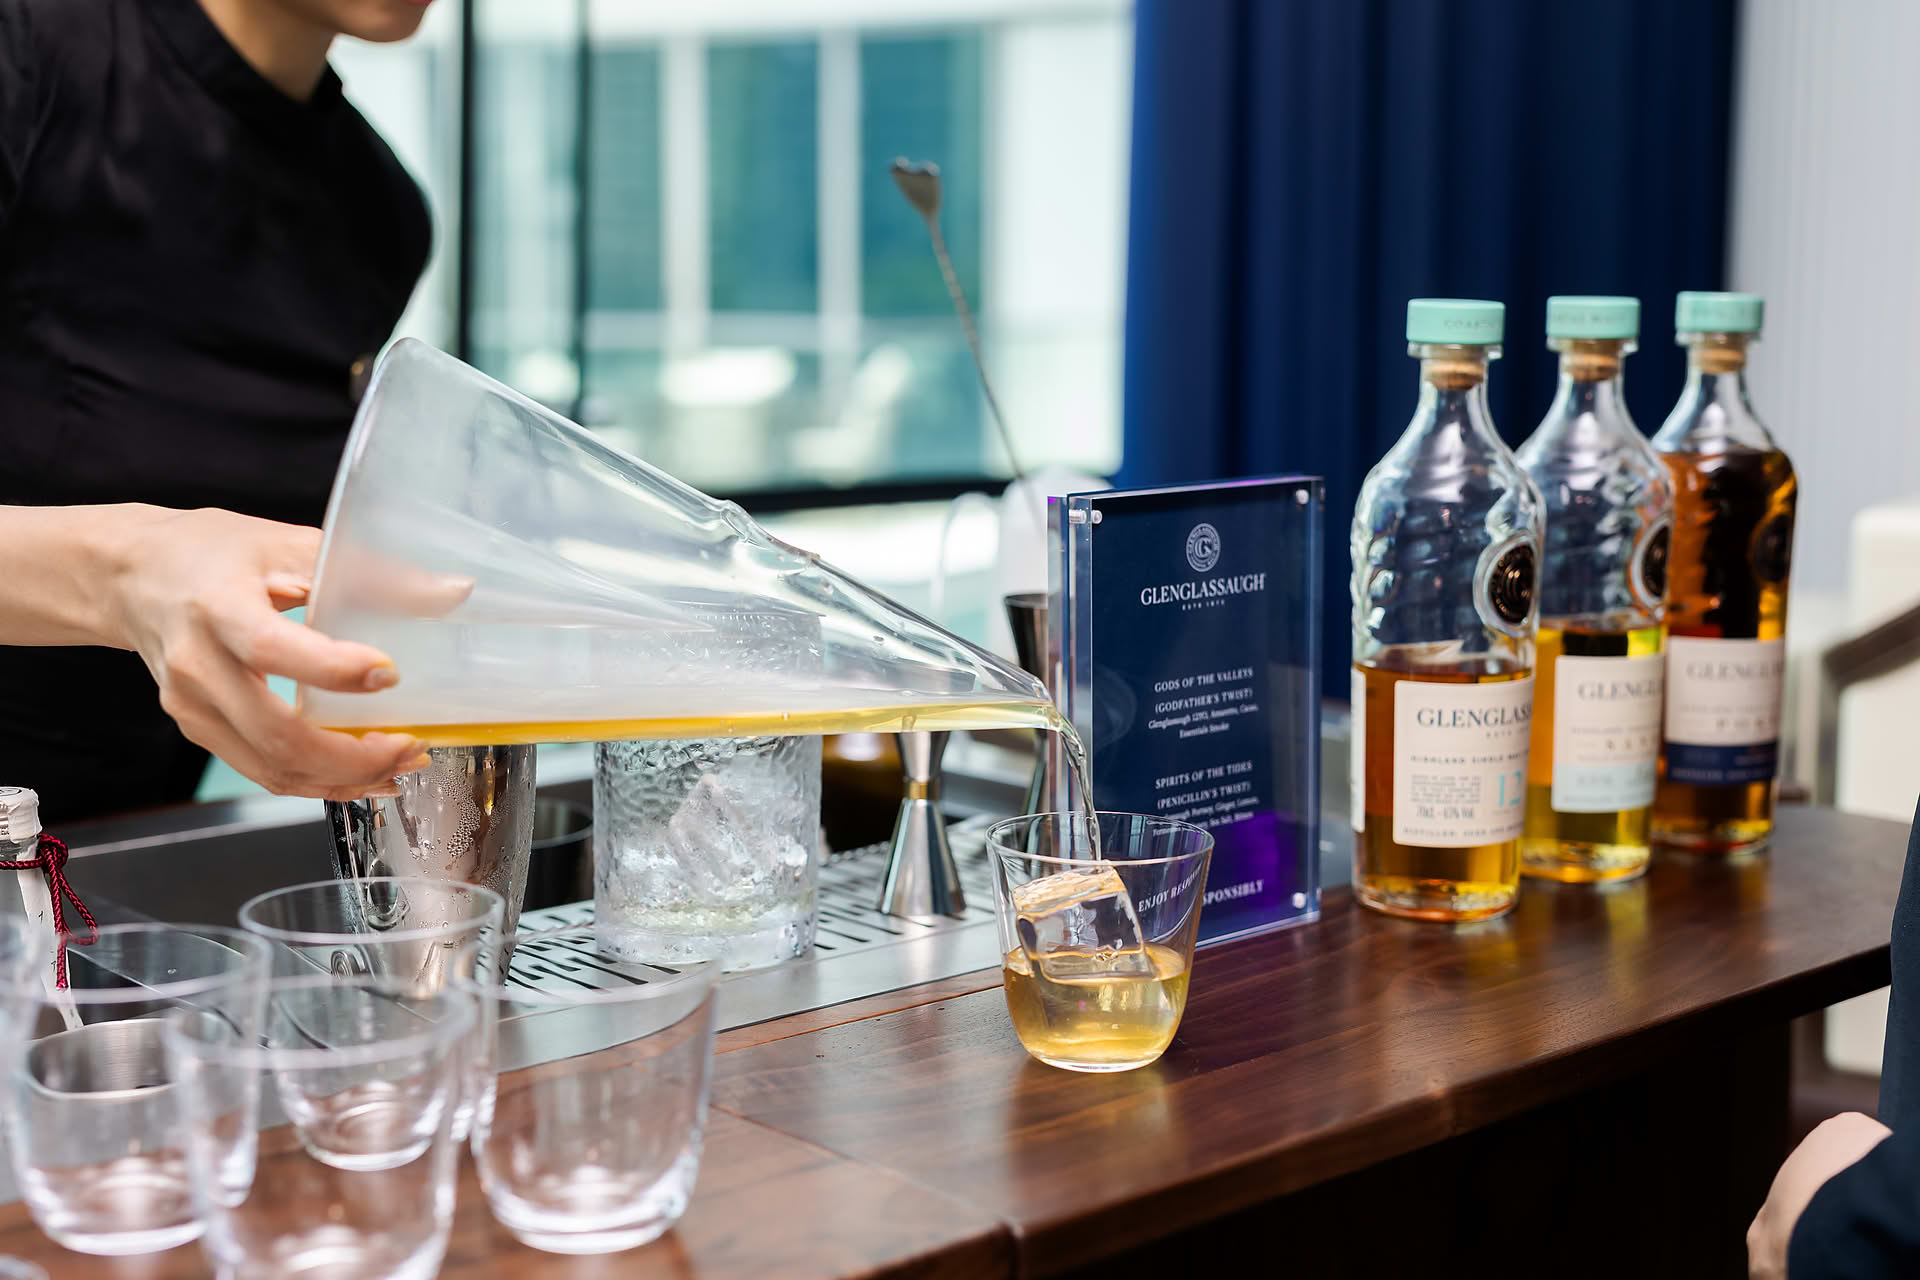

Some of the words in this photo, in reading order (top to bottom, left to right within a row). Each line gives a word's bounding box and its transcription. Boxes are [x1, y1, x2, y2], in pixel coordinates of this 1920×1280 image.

[1140, 573, 1265, 606] GLENGLASSAUGH
[1154, 679, 1180, 693] GODS
[1181, 676, 1195, 689] OF
[1197, 673, 1215, 686] THE
[1216, 667, 1254, 682] VALLEYS
[1155, 772, 1190, 790] SPIRITS
[1191, 770, 1204, 783] OF
[1206, 766, 1225, 779] THE
[1226, 761, 1253, 776] TIDES
[1138, 889, 1170, 913] ENJOY
